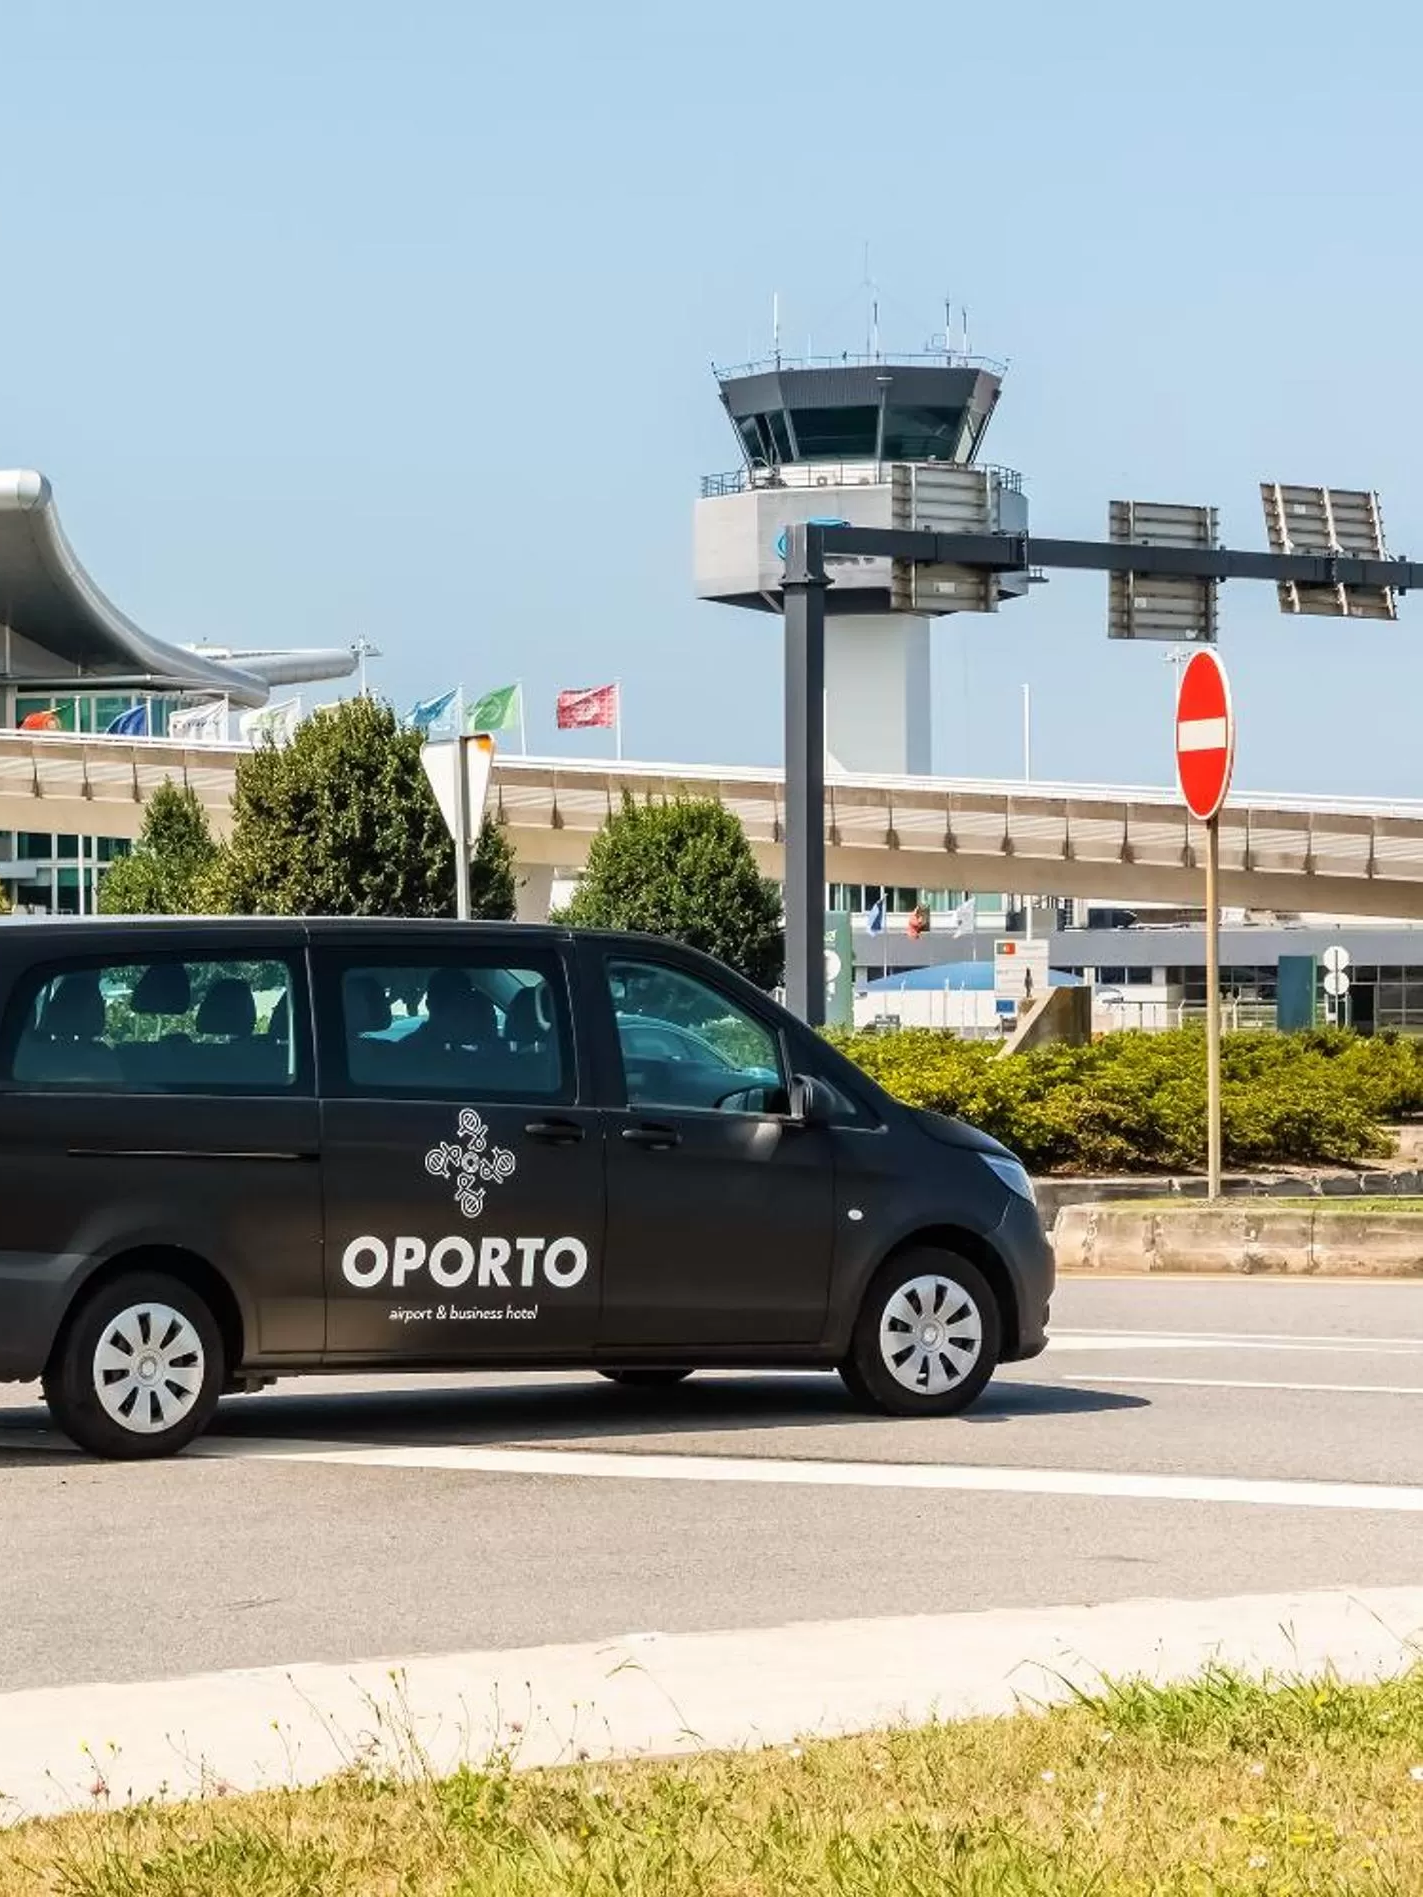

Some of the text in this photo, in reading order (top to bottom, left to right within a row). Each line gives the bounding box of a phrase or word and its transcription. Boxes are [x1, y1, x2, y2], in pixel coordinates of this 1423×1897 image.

[342, 1235, 588, 1288] OPORTO
[388, 1304, 538, 1324] airport & business hotel
